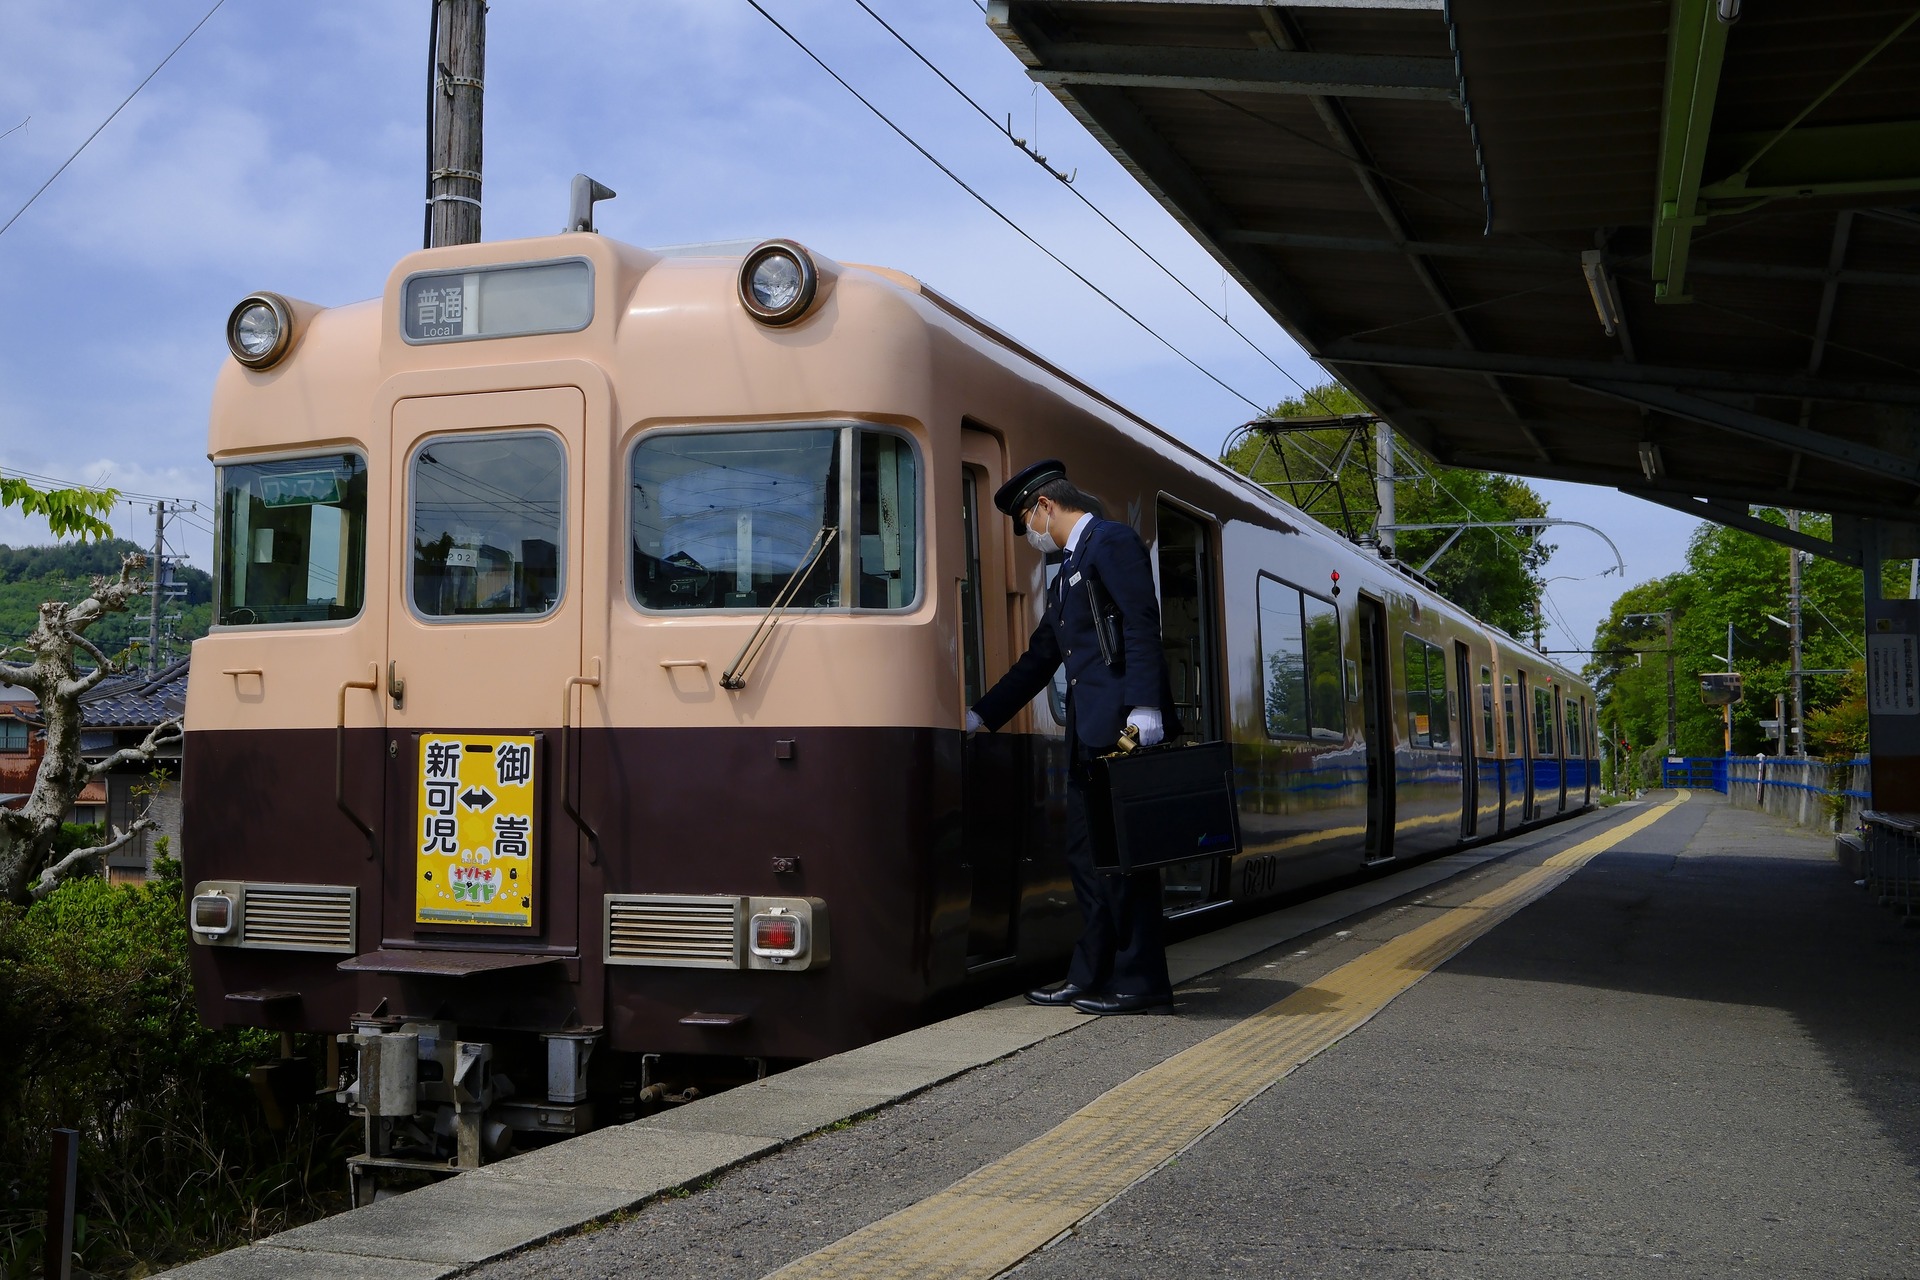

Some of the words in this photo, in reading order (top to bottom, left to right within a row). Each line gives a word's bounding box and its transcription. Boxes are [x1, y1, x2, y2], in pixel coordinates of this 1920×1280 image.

[418, 287, 462, 326] 普通
[423, 324, 454, 337] Local
[263, 477, 334, 505] ワンマン
[424, 742, 460, 853] 新可児
[495, 744, 530, 857] 御嵩
[455, 867, 492, 881] ナゾトキ
[453, 881, 495, 901] ライド
